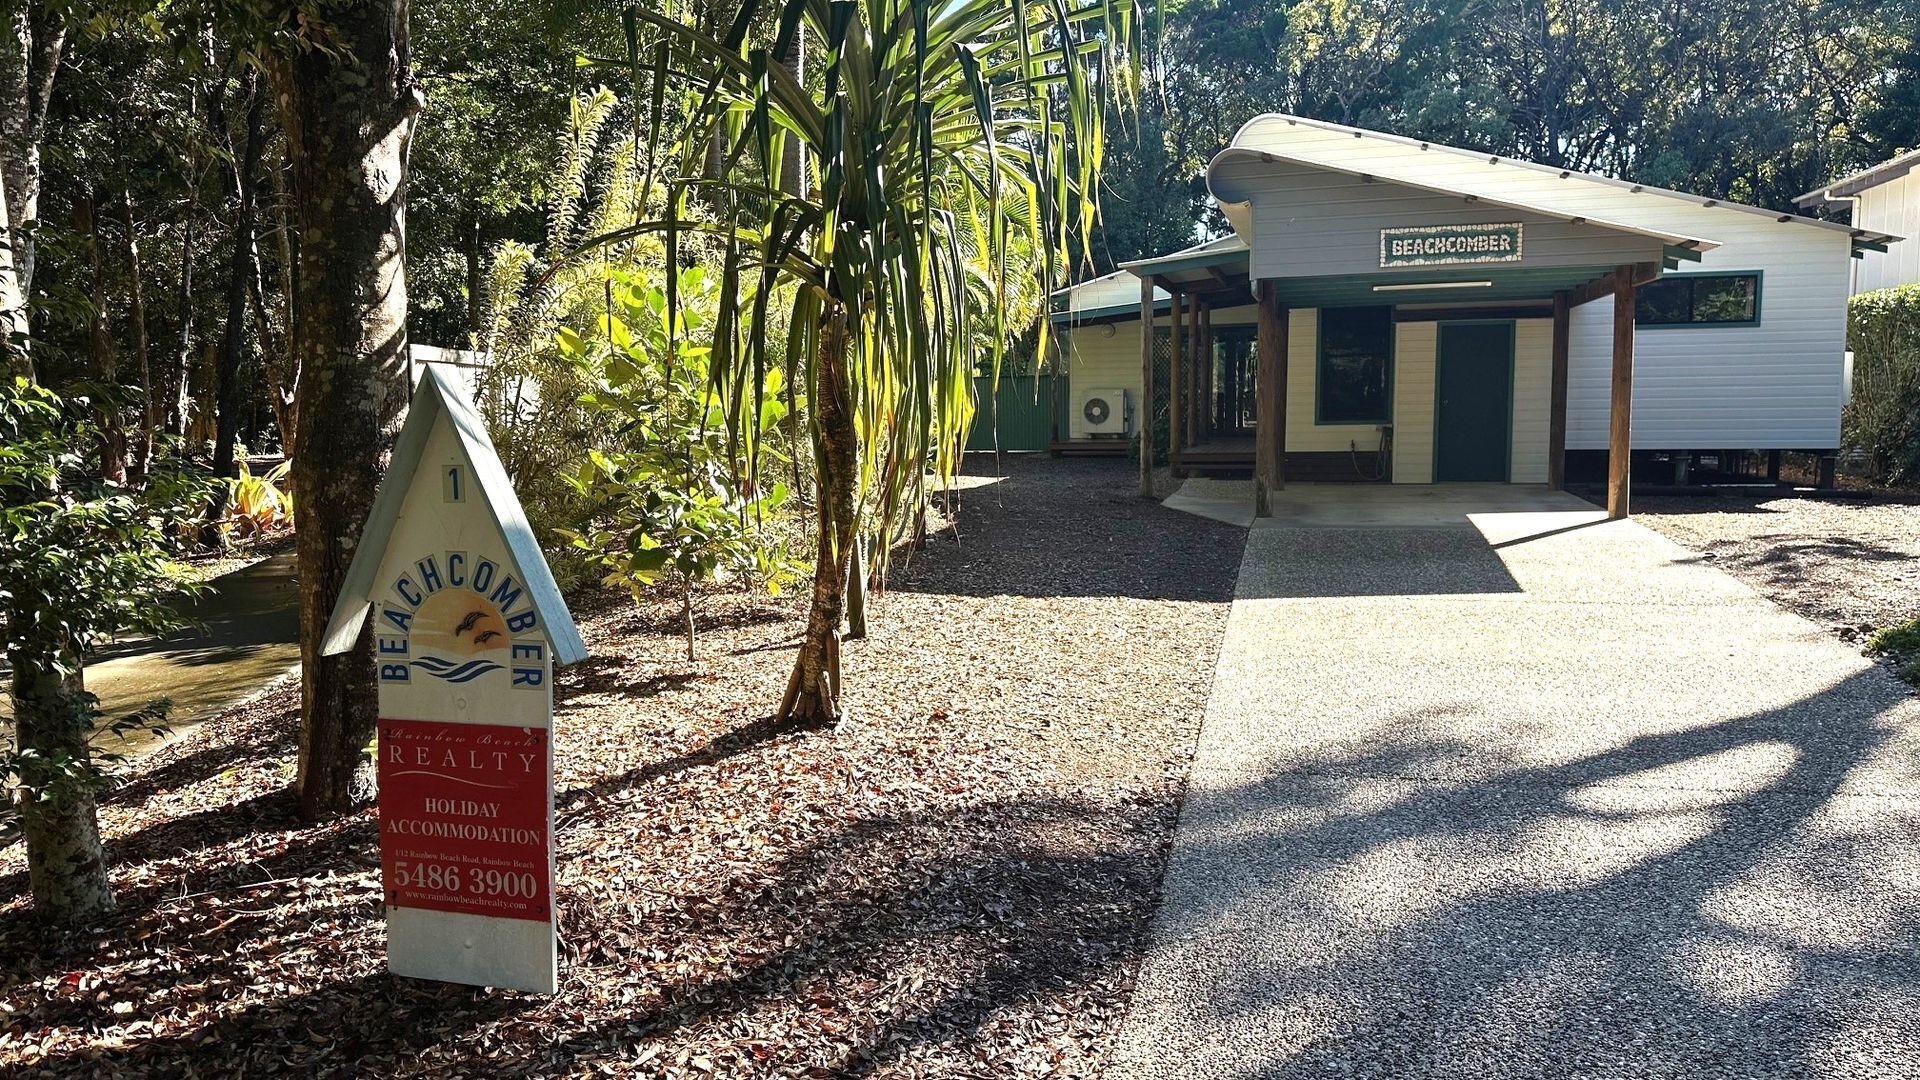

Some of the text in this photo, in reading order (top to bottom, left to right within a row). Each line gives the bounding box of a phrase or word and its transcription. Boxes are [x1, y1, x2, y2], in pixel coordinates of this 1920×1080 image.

[1392, 234, 1511, 256] BEACHCOMBER
[448, 468, 460, 500] 1
[379, 553, 544, 686] BEACHCOMBER
[389, 728, 534, 747] Rainbow Beach
[389, 745, 536, 772] REALTY
[425, 798, 501, 818] HOLIDAY
[387, 820, 541, 846] ACCOMMODATION
[410, 850, 438, 860] Rainbow
[440, 853, 461, 863] Beach
[462, 855, 481, 865] Road,
[483, 857, 511, 867] Rainbow
[513, 859, 535, 869] Beach
[394, 861, 537, 899] 5486 3900
[405, 890, 527, 910] www.rainbowbeachrealty.com
